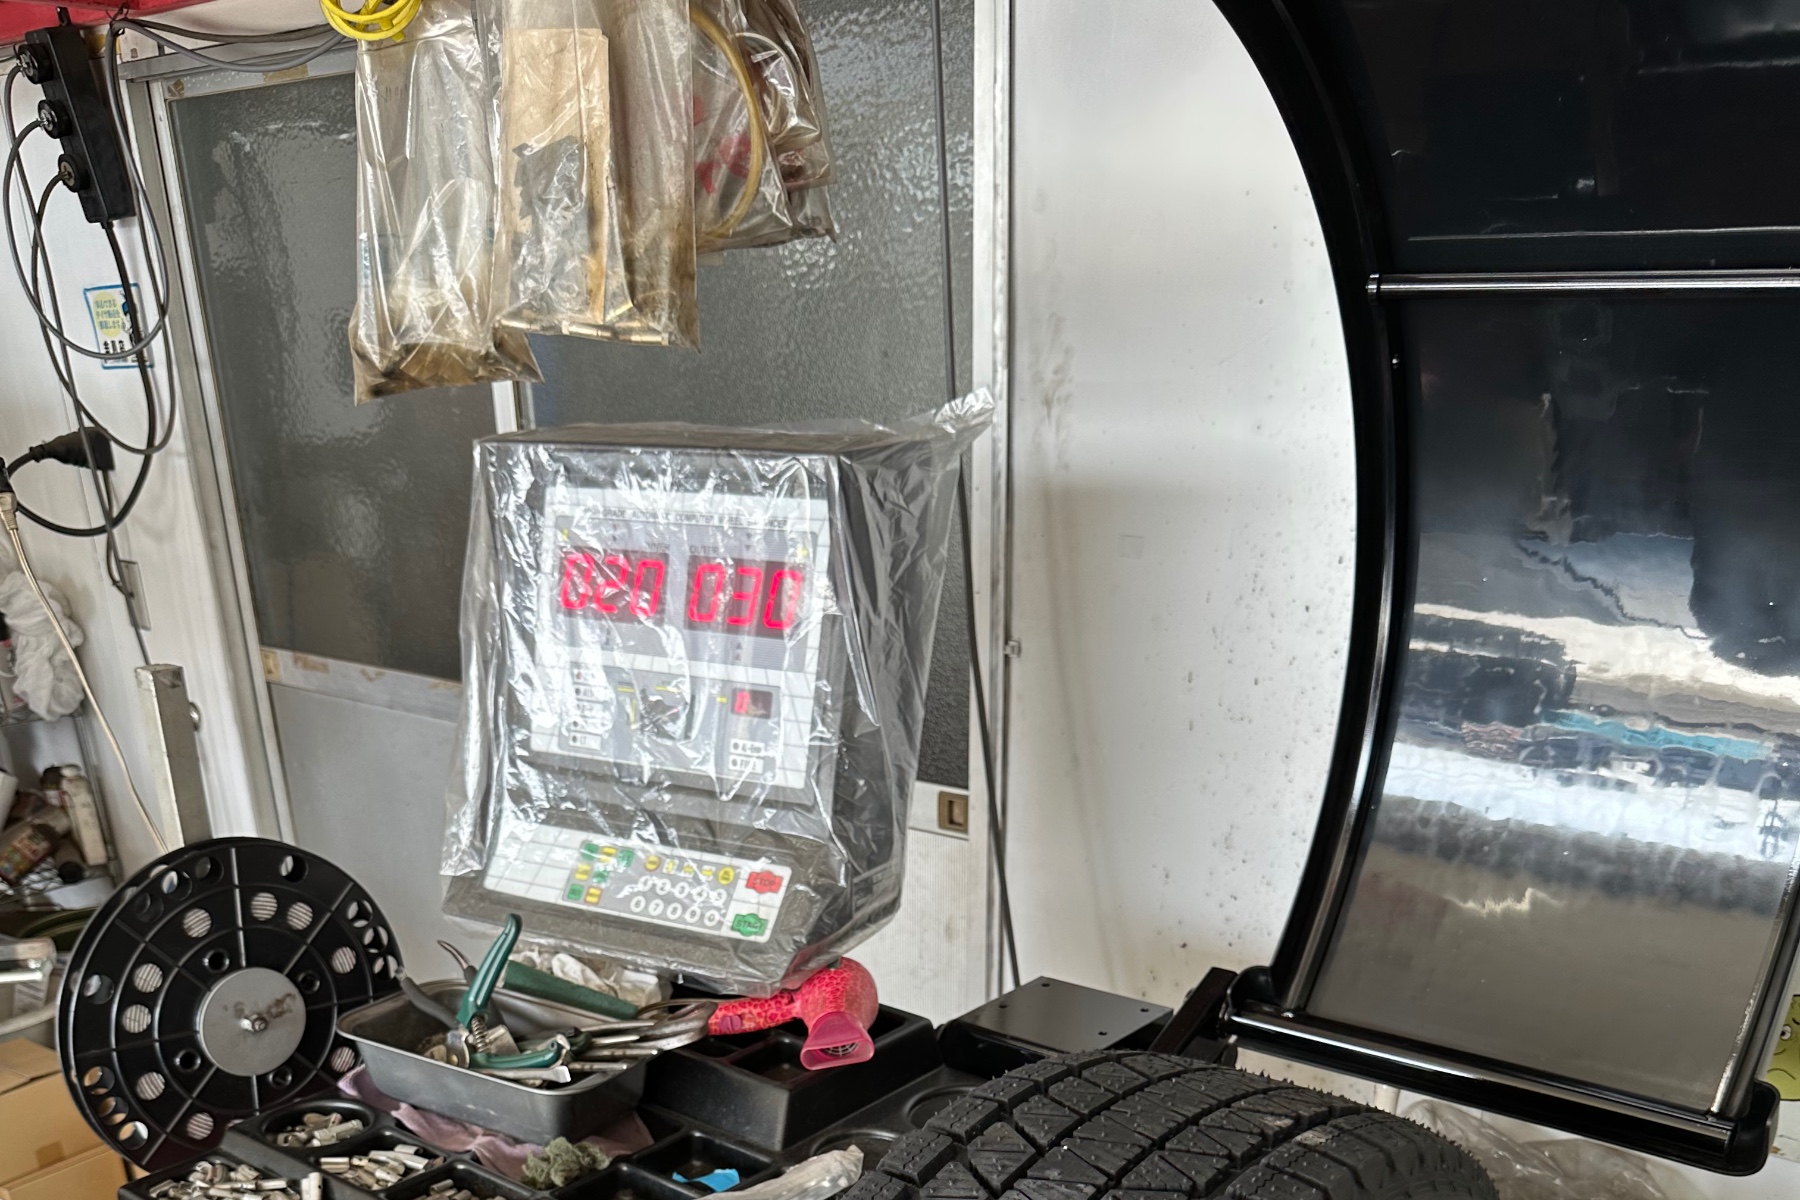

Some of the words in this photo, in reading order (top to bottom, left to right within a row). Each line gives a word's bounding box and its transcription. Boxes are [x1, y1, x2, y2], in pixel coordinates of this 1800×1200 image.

[560, 552, 666, 618] 020
[687, 562, 803, 630] 030
[752, 877, 777, 887] STOP
